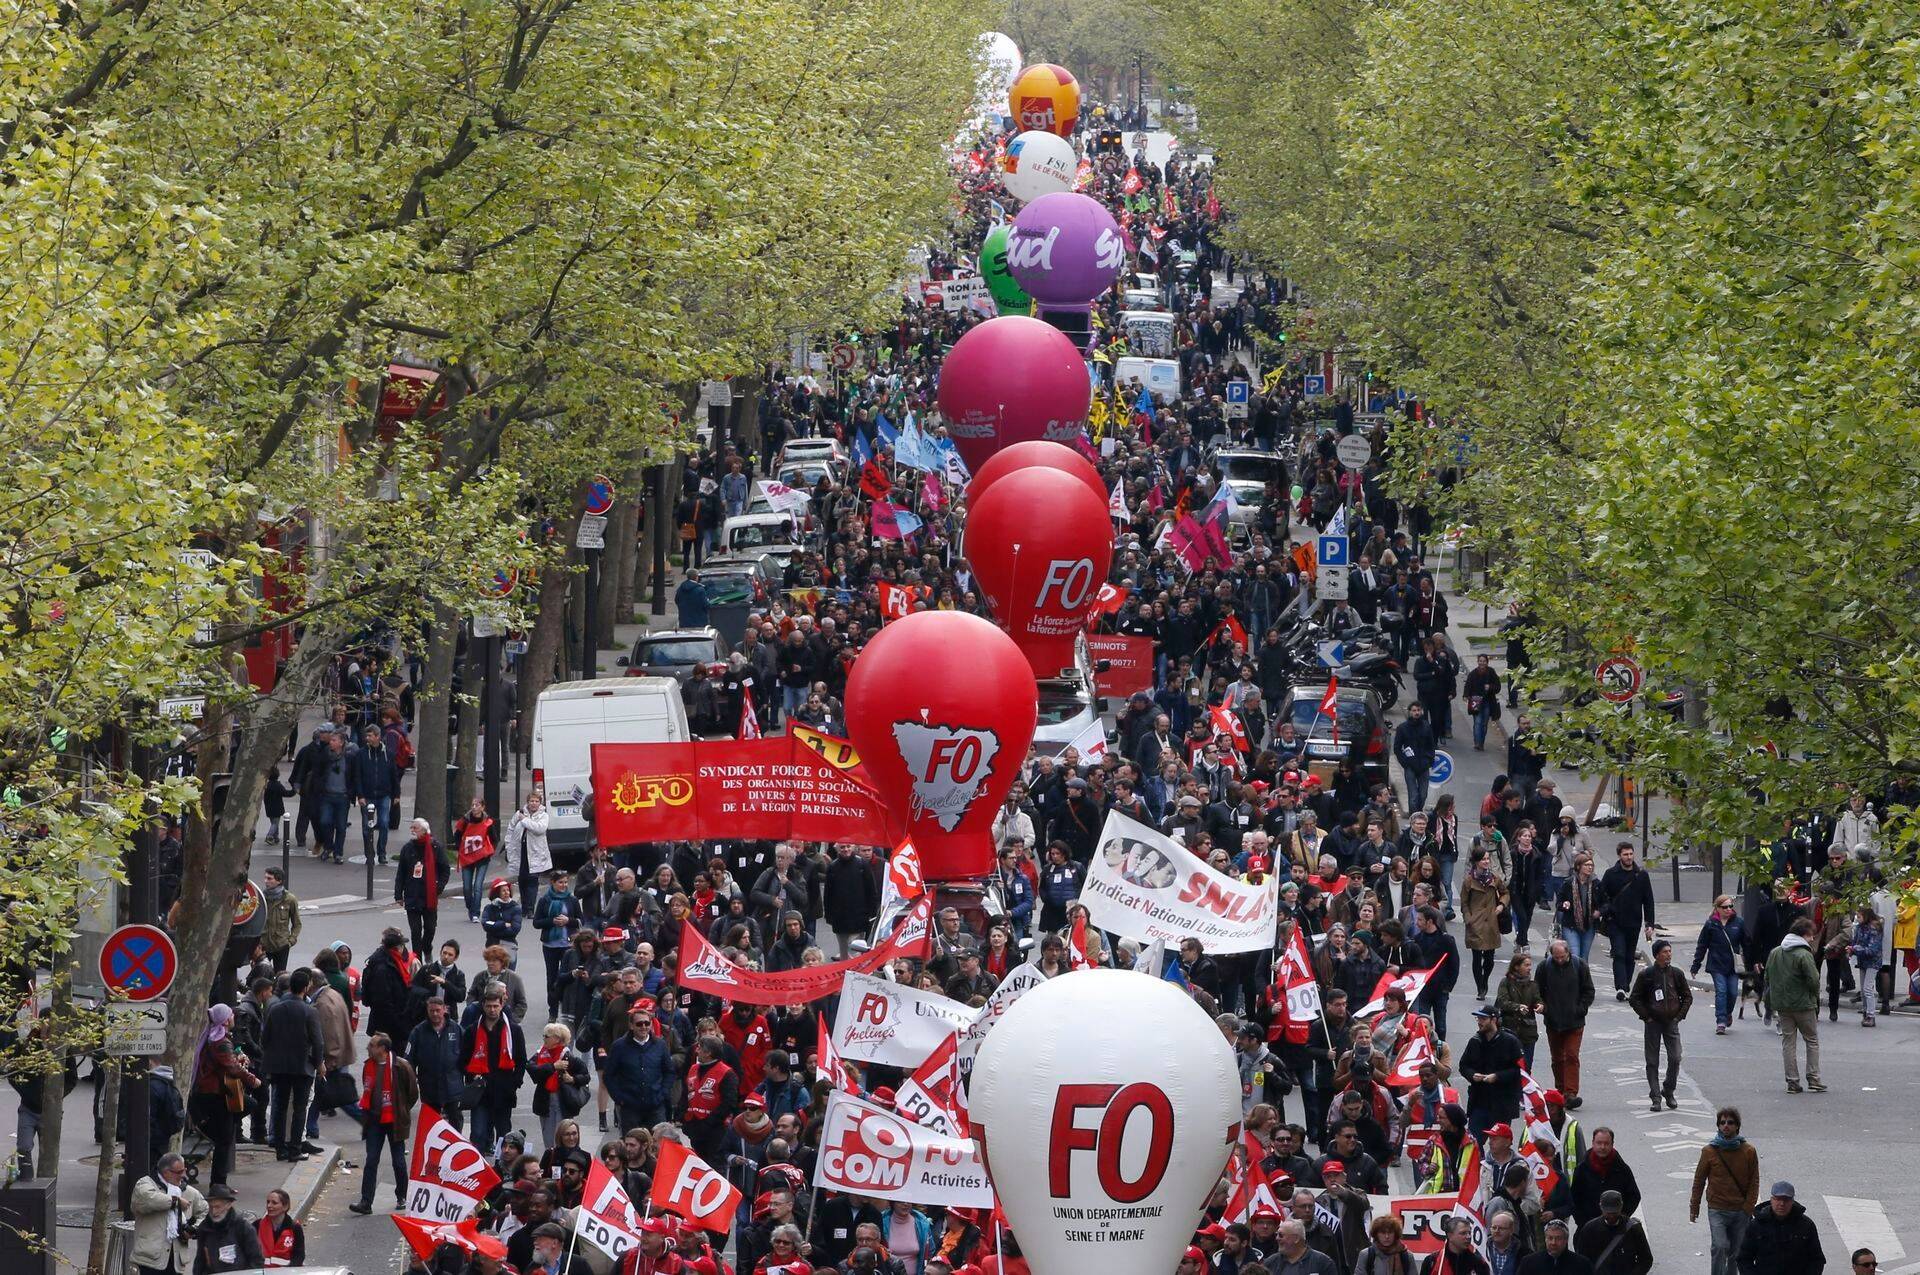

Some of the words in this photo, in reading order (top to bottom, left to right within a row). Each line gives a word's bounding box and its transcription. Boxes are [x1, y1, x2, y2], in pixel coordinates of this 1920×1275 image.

[1021, 107, 1056, 130] cgt
[1046, 156, 1069, 173] FSU
[947, 284, 970, 293] NON
[1233, 385, 1242, 399] P
[1326, 541, 1340, 561] P
[1035, 557, 1094, 610] FO
[1026, 621, 1036, 633] La
[1036, 622, 1057, 635] Force
[1033, 613, 1043, 624] La
[1044, 614, 1063, 625] Force
[699, 765, 765, 777] SYNDICAT
[772, 765, 812, 777] FORCE
[924, 735, 983, 784] FO
[722, 779, 743, 789] DES
[747, 778, 814, 790] ORGANISMES
[748, 790, 785, 801] DIVERS
[788, 791, 796, 801] &
[800, 792, 840, 804] DIVERS
[910, 782, 989, 822] Yvelines
[722, 803, 737, 812] DE
[742, 803, 756, 812] LA
[761, 801, 797, 813] RÉGION
[801, 804, 866, 818] PARISIENNE
[1178, 871, 1275, 923] SNLA
[1142, 899, 1199, 932] National
[1196, 919, 1229, 937] Libre
[1146, 924, 1175, 942] Force
[857, 991, 888, 1025] FO
[844, 1022, 896, 1048] Yvelines
[904, 1091, 931, 1119] FO
[827, 1103, 914, 1160] FO
[1048, 1081, 1175, 1204] FO
[420, 1118, 486, 1183] FO
[823, 1149, 906, 1188] COM
[920, 1171, 981, 1189] Activités
[668, 1153, 731, 1218] FO
[410, 1187, 431, 1214] FO
[1053, 1206, 1084, 1220] UNION
[584, 1216, 611, 1246] FO
[1065, 1230, 1094, 1243] SEINE
[1095, 1231, 1107, 1243] ET
[1108, 1229, 1146, 1242] MARNE
